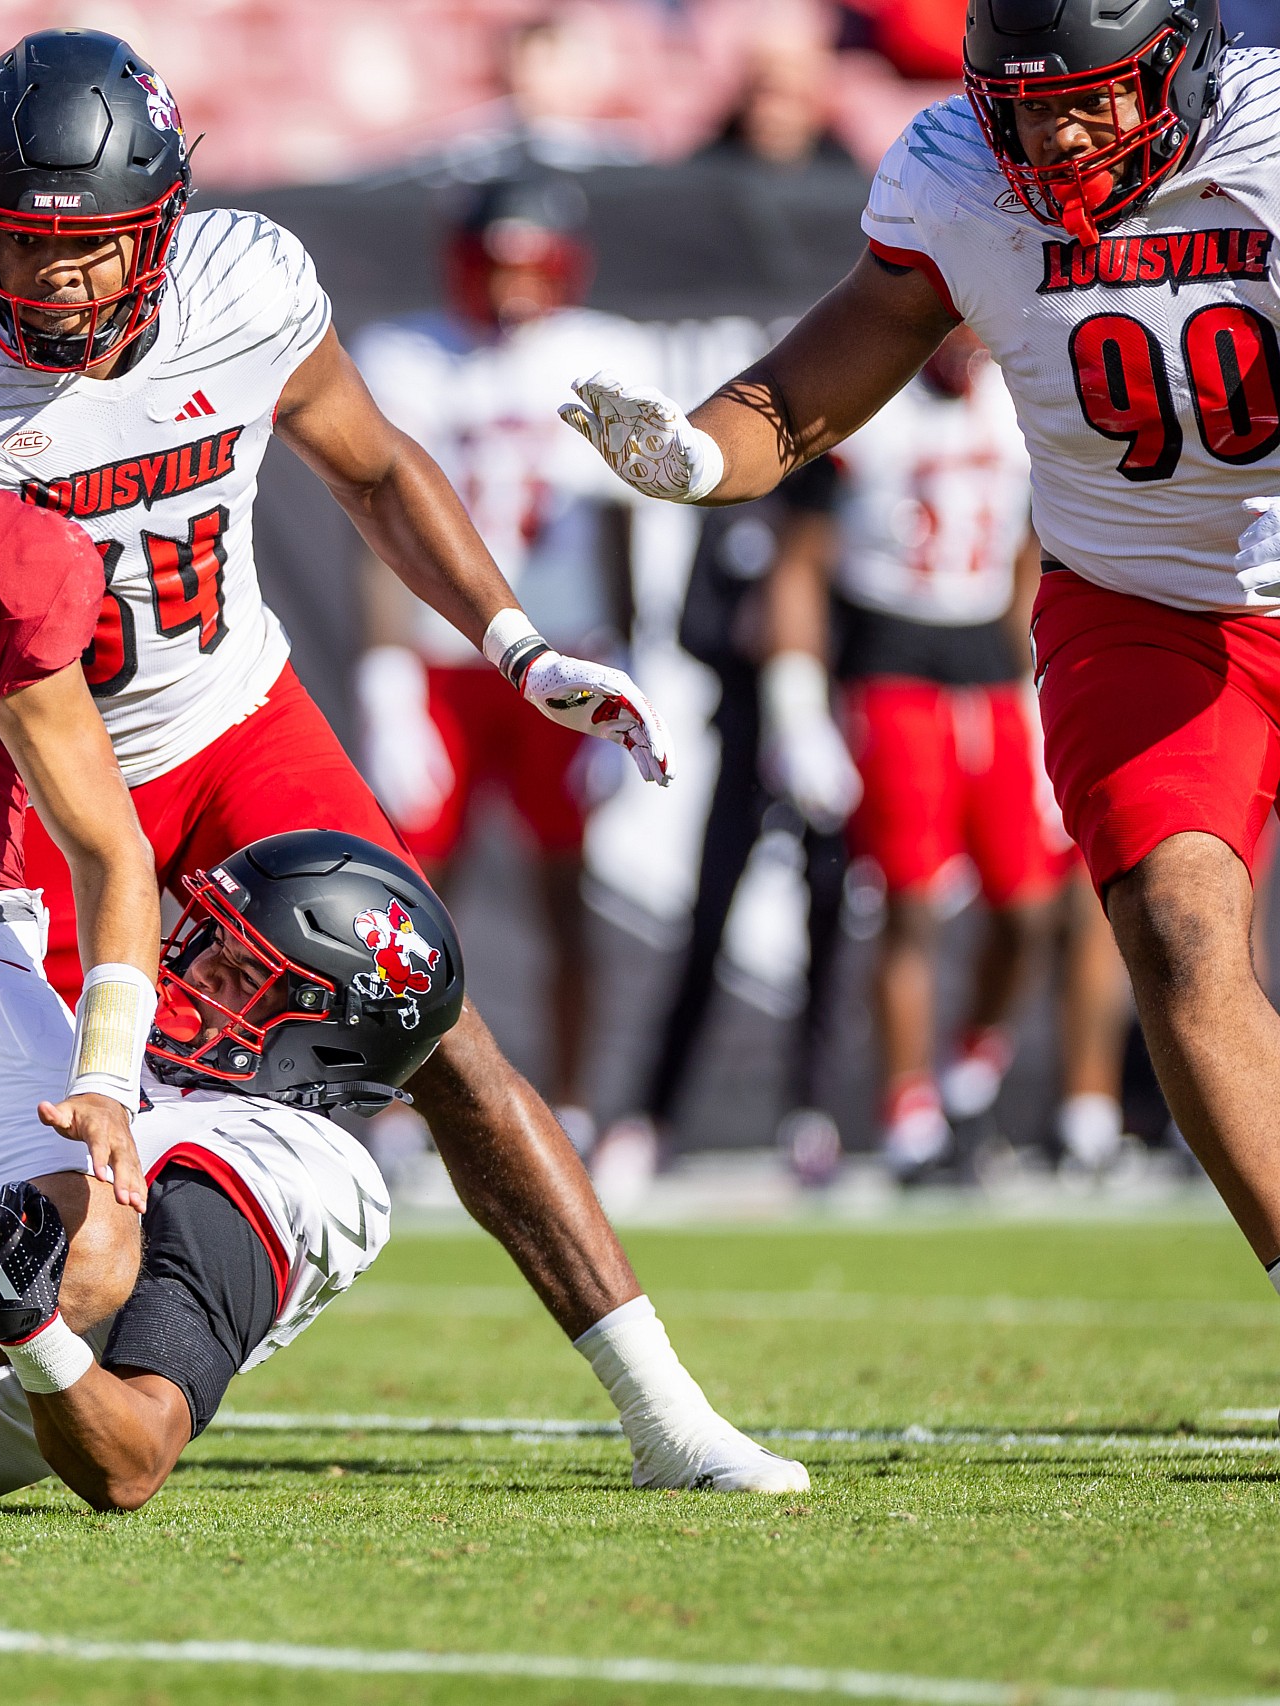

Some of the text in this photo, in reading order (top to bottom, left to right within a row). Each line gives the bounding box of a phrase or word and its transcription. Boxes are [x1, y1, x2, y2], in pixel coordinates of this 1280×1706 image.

[1004, 59, 1046, 75] THE VILLE
[32, 194, 82, 209] THE VILLE
[1036, 227, 1274, 296] LOUISVILLE
[1068, 301, 1280, 482] 90
[10, 435, 44, 448] ACC
[20, 424, 245, 520] LOUISVILLE
